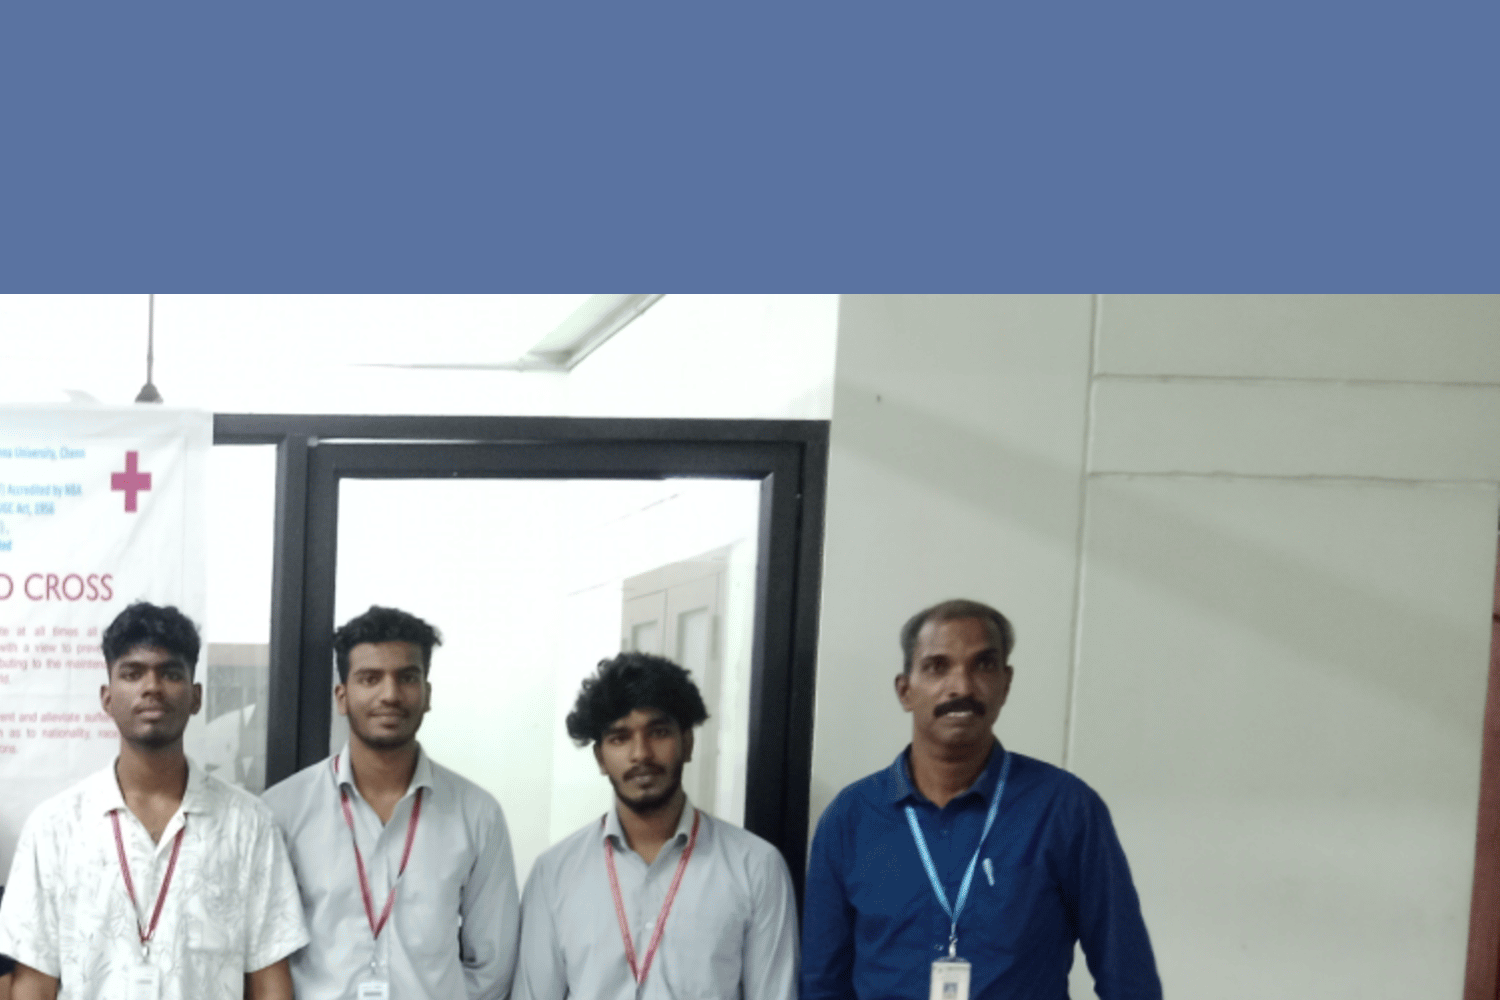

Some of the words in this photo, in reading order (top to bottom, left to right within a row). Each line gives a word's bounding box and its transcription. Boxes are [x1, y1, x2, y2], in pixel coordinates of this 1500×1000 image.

[7, 484, 50, 496] Accredited
[52, 485, 62, 499] by
[24, 573, 114, 602] CROSS
[17, 626, 26, 636] at
[34, 626, 45, 637] all
[53, 626, 78, 637] times
[0, 643, 18, 652] with
[24, 644, 30, 652] a
[35, 644, 56, 652] view
[62, 644, 71, 653] to
[32, 658, 42, 669] to
[46, 659, 61, 669] the
[19, 712, 37, 722] and
[41, 712, 80, 722] alleviate
[10, 729, 20, 738] as
[26, 728, 36, 738] to
